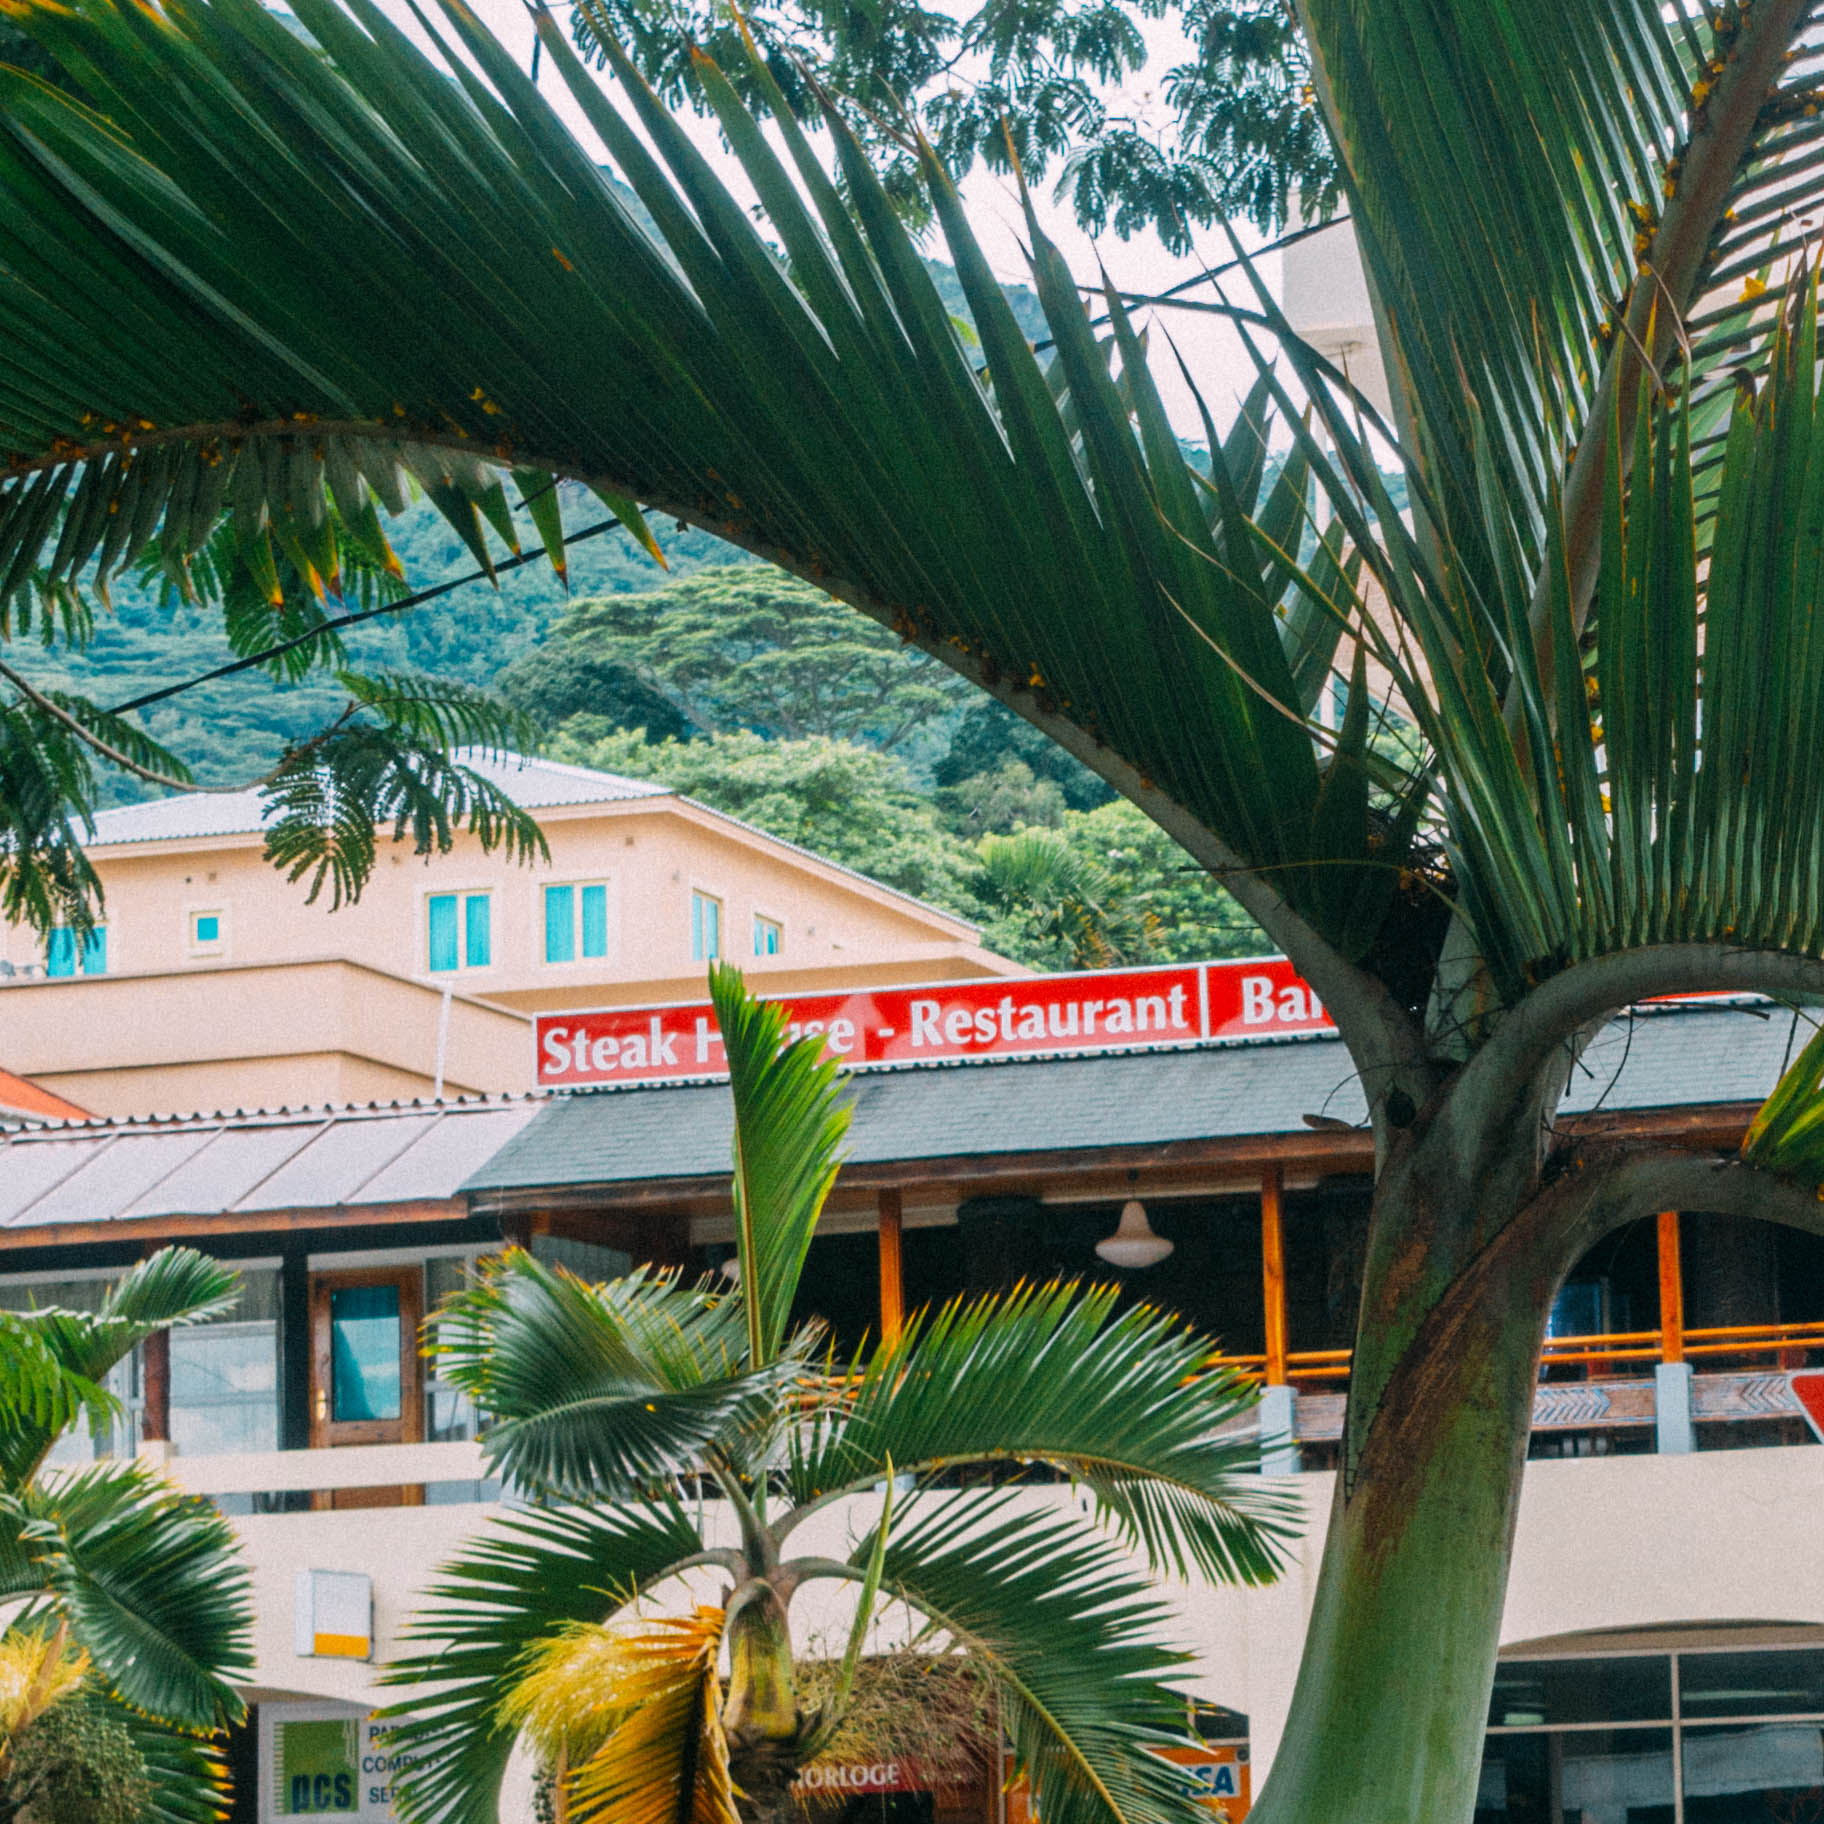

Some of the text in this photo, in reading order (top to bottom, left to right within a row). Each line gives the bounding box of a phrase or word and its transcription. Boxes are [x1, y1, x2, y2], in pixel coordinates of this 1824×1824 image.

[542, 1016, 679, 1075] Steak
[695, 1016, 855, 1064] Hse
[911, 983, 1189, 1048] Restaurant
[796, 1763, 900, 1789] ORLOGE
